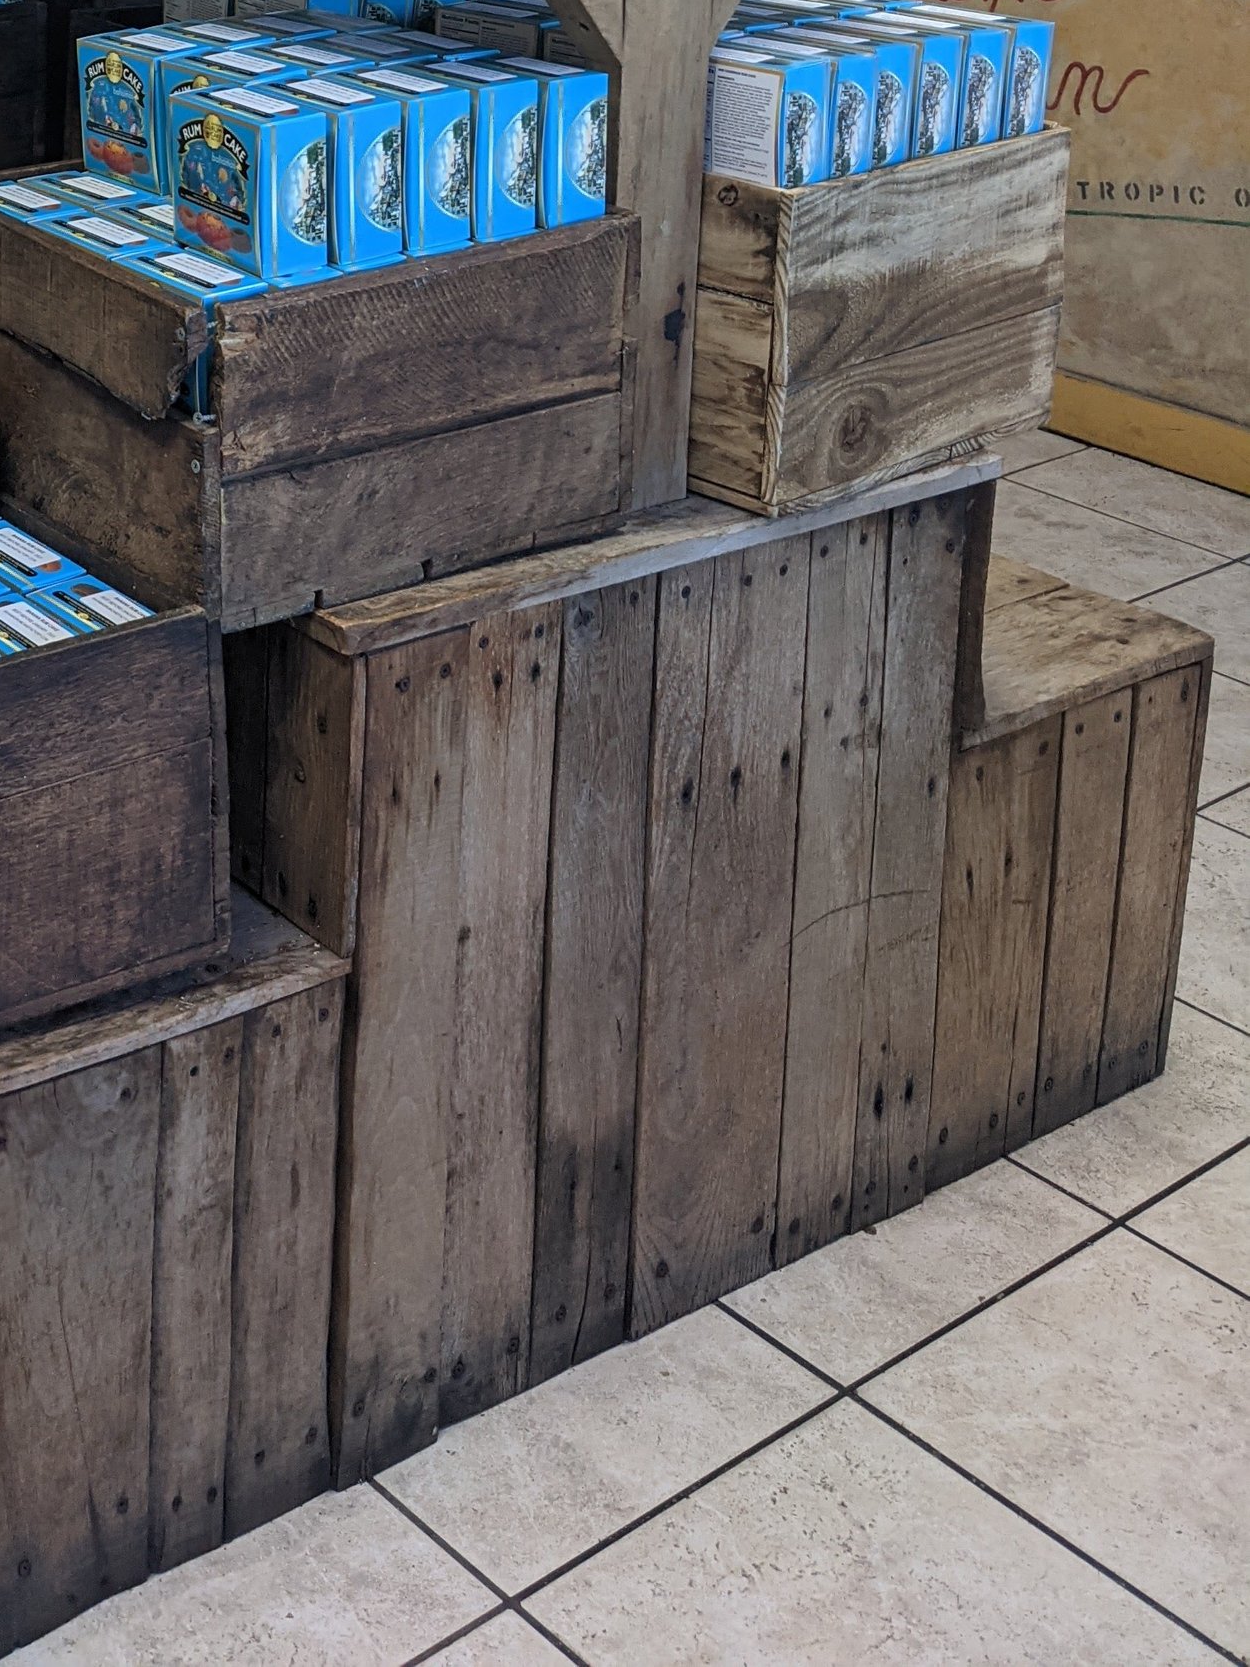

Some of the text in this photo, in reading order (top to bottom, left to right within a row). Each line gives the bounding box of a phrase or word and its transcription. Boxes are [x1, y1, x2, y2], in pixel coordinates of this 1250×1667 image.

[88, 61, 142, 92] RUM CAKE
[183, 123, 247, 163] RUM CAKE
[1077, 181, 1206, 206] TROPIC
